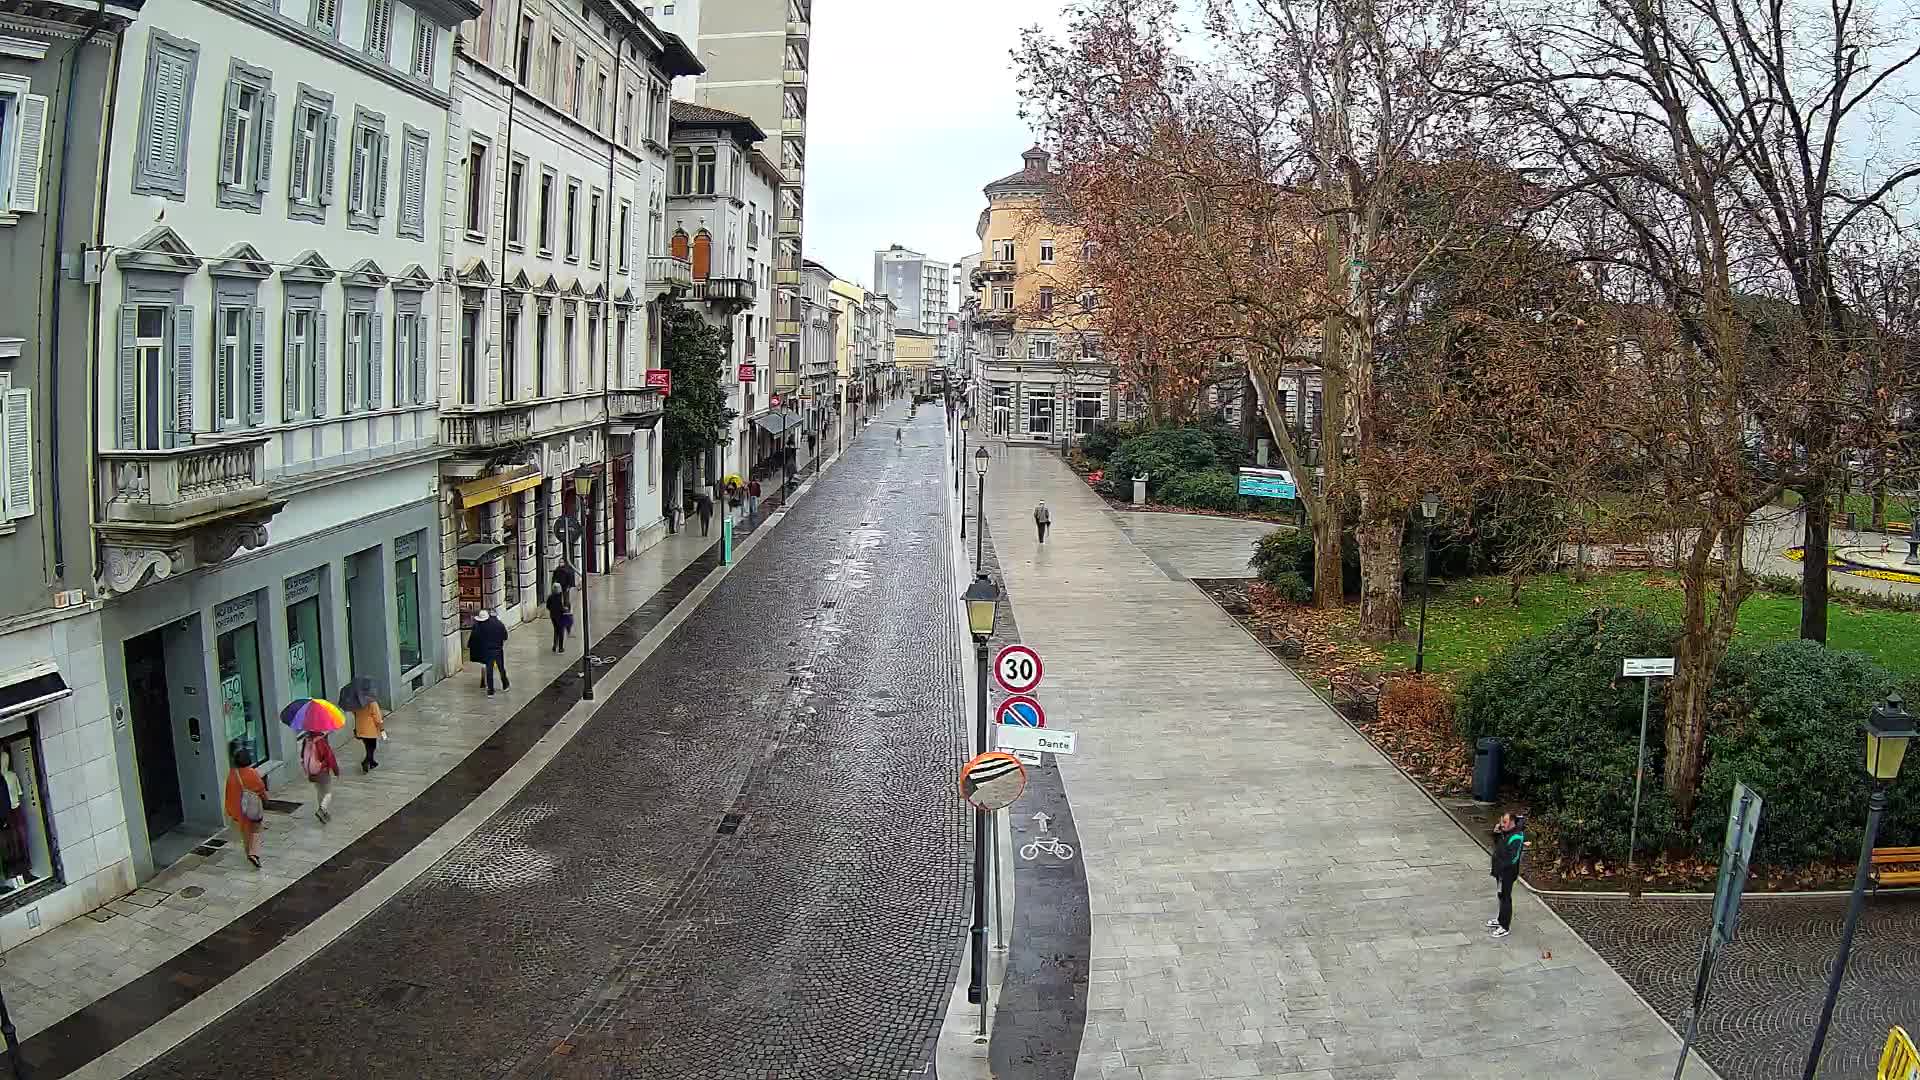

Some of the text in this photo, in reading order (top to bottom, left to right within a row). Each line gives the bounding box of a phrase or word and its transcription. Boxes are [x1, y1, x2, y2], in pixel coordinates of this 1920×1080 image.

[1005, 658, 1033, 680] 30
[223, 678, 240, 699] 130
[1038, 738, 1070, 750] Dante
